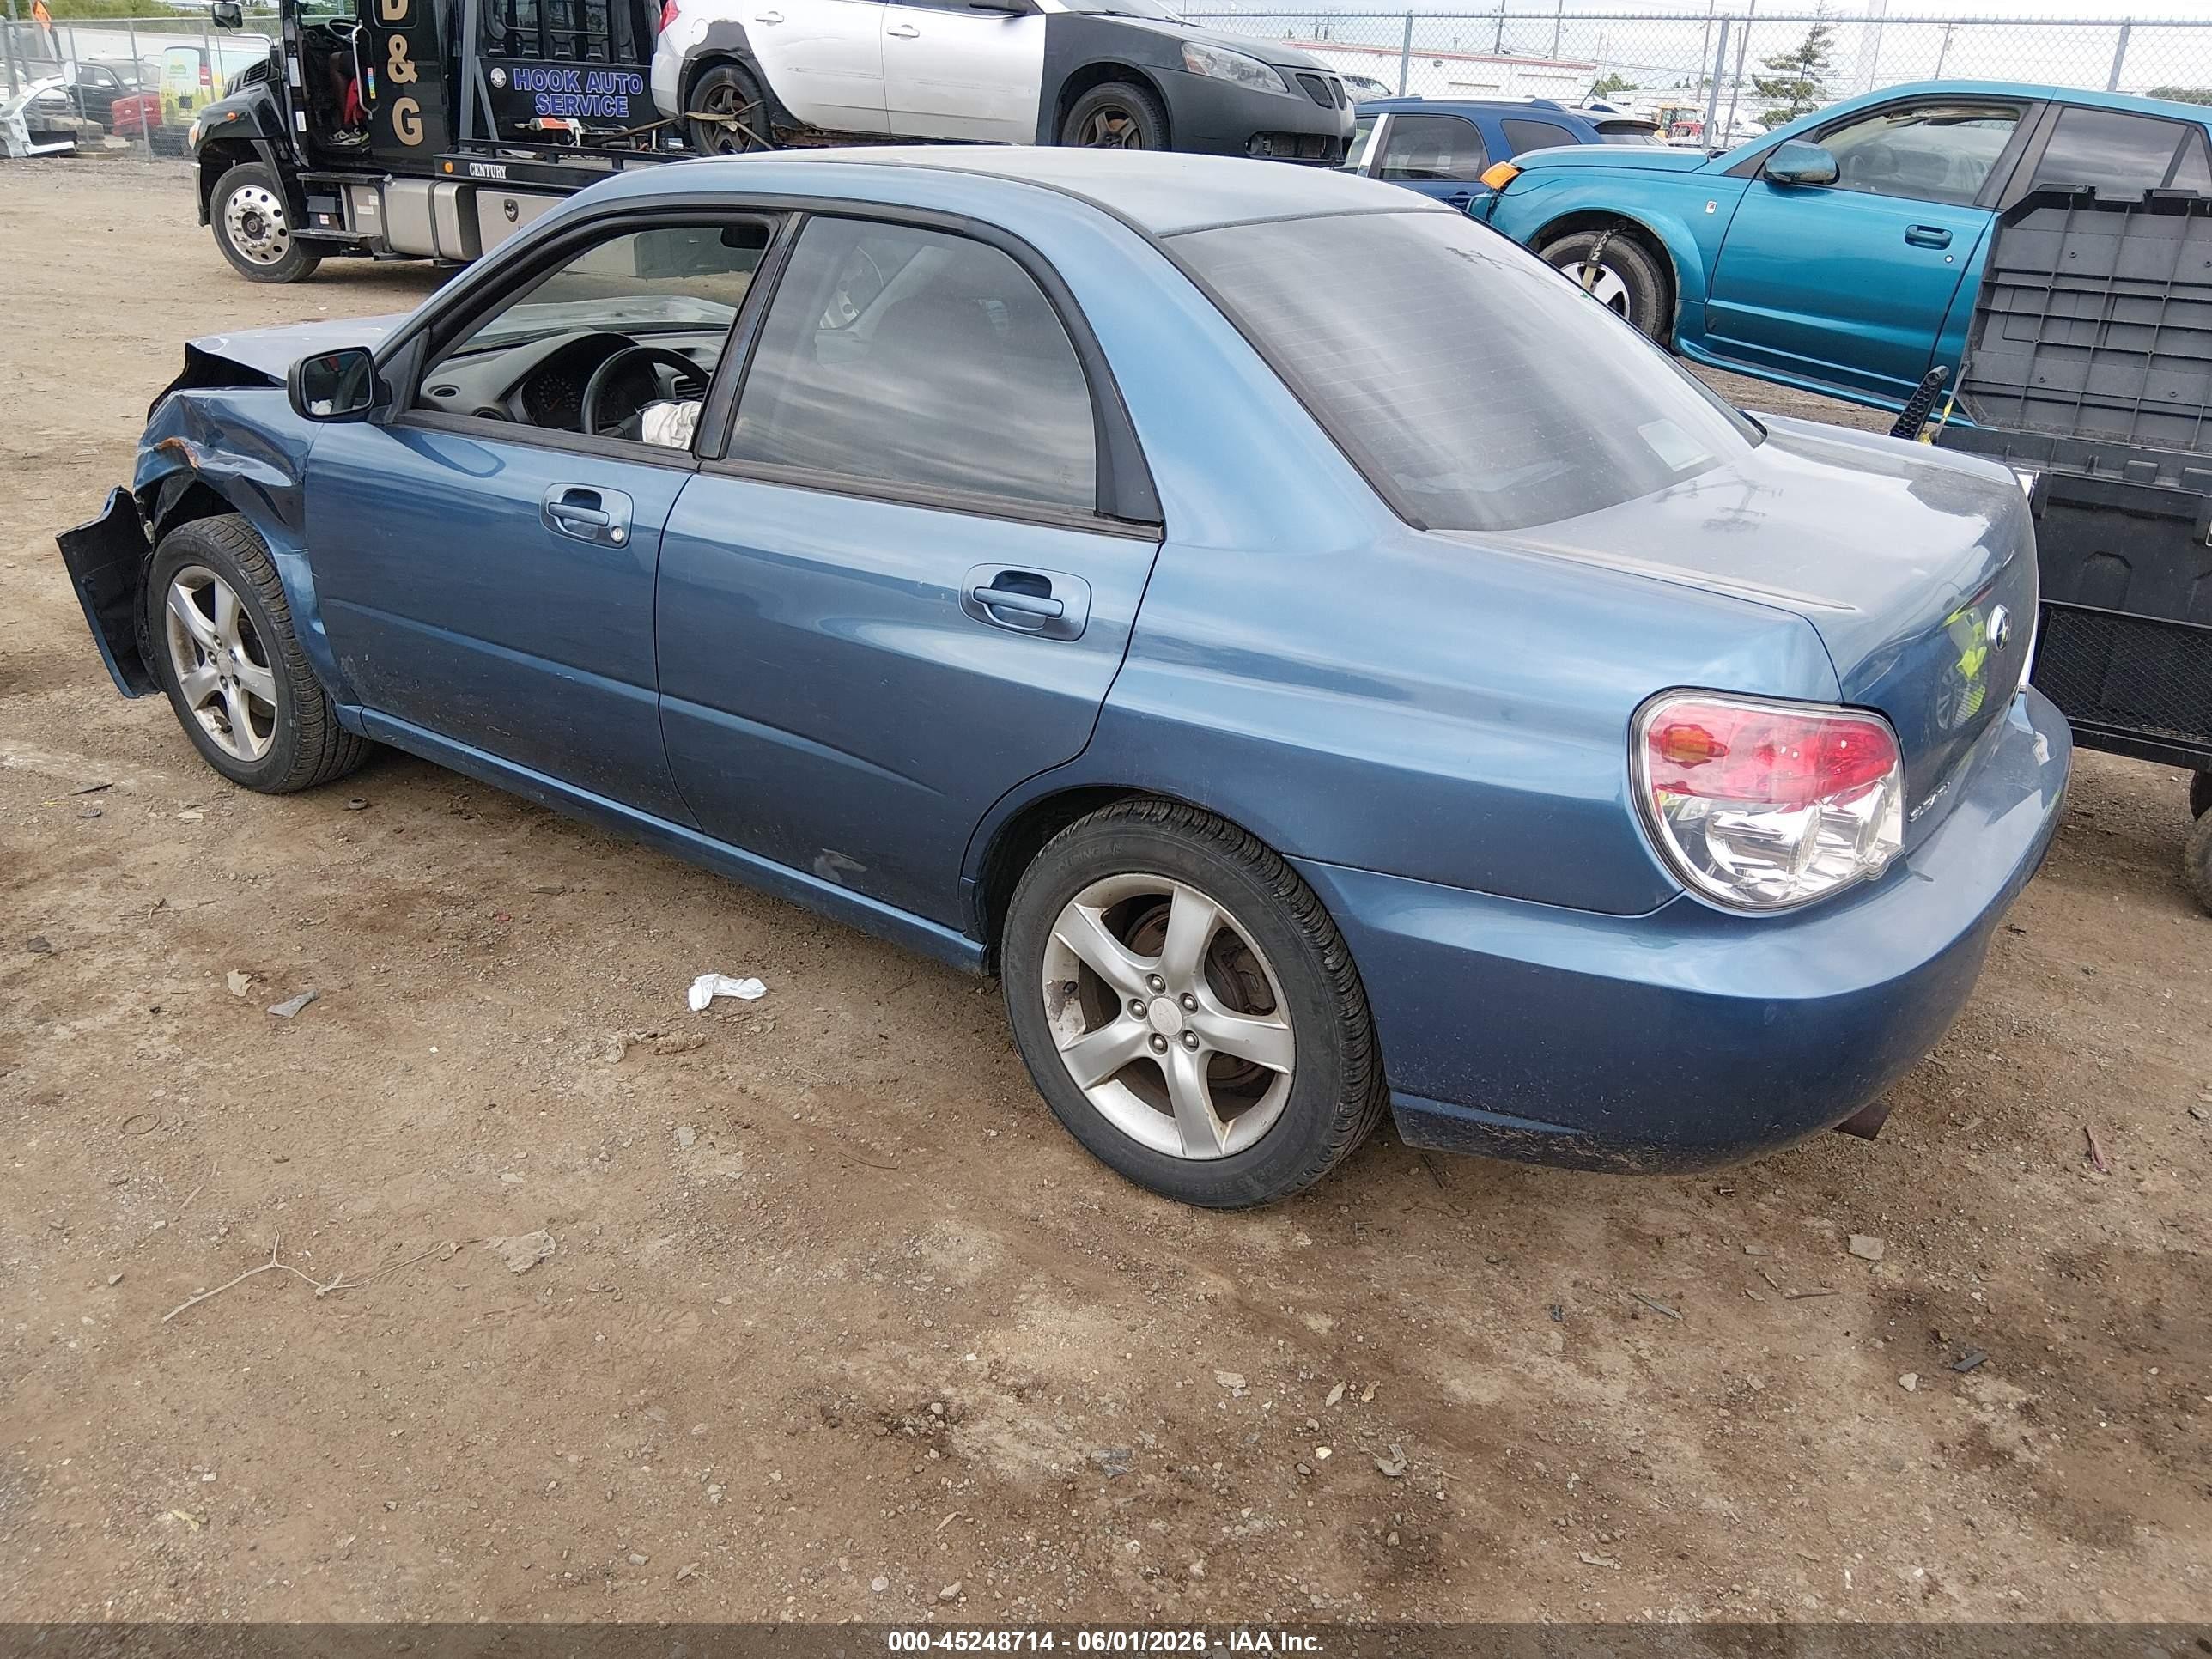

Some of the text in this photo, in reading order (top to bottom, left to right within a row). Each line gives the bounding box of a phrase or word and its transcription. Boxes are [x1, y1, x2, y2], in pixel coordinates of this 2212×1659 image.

[387, 34, 418, 83] &
[513, 68, 582, 93] HOOK
[586, 71, 644, 96] AUTO
[535, 93, 629, 118] SERVICE
[392, 97, 424, 146] G
[469, 162, 507, 179] CENTURY
